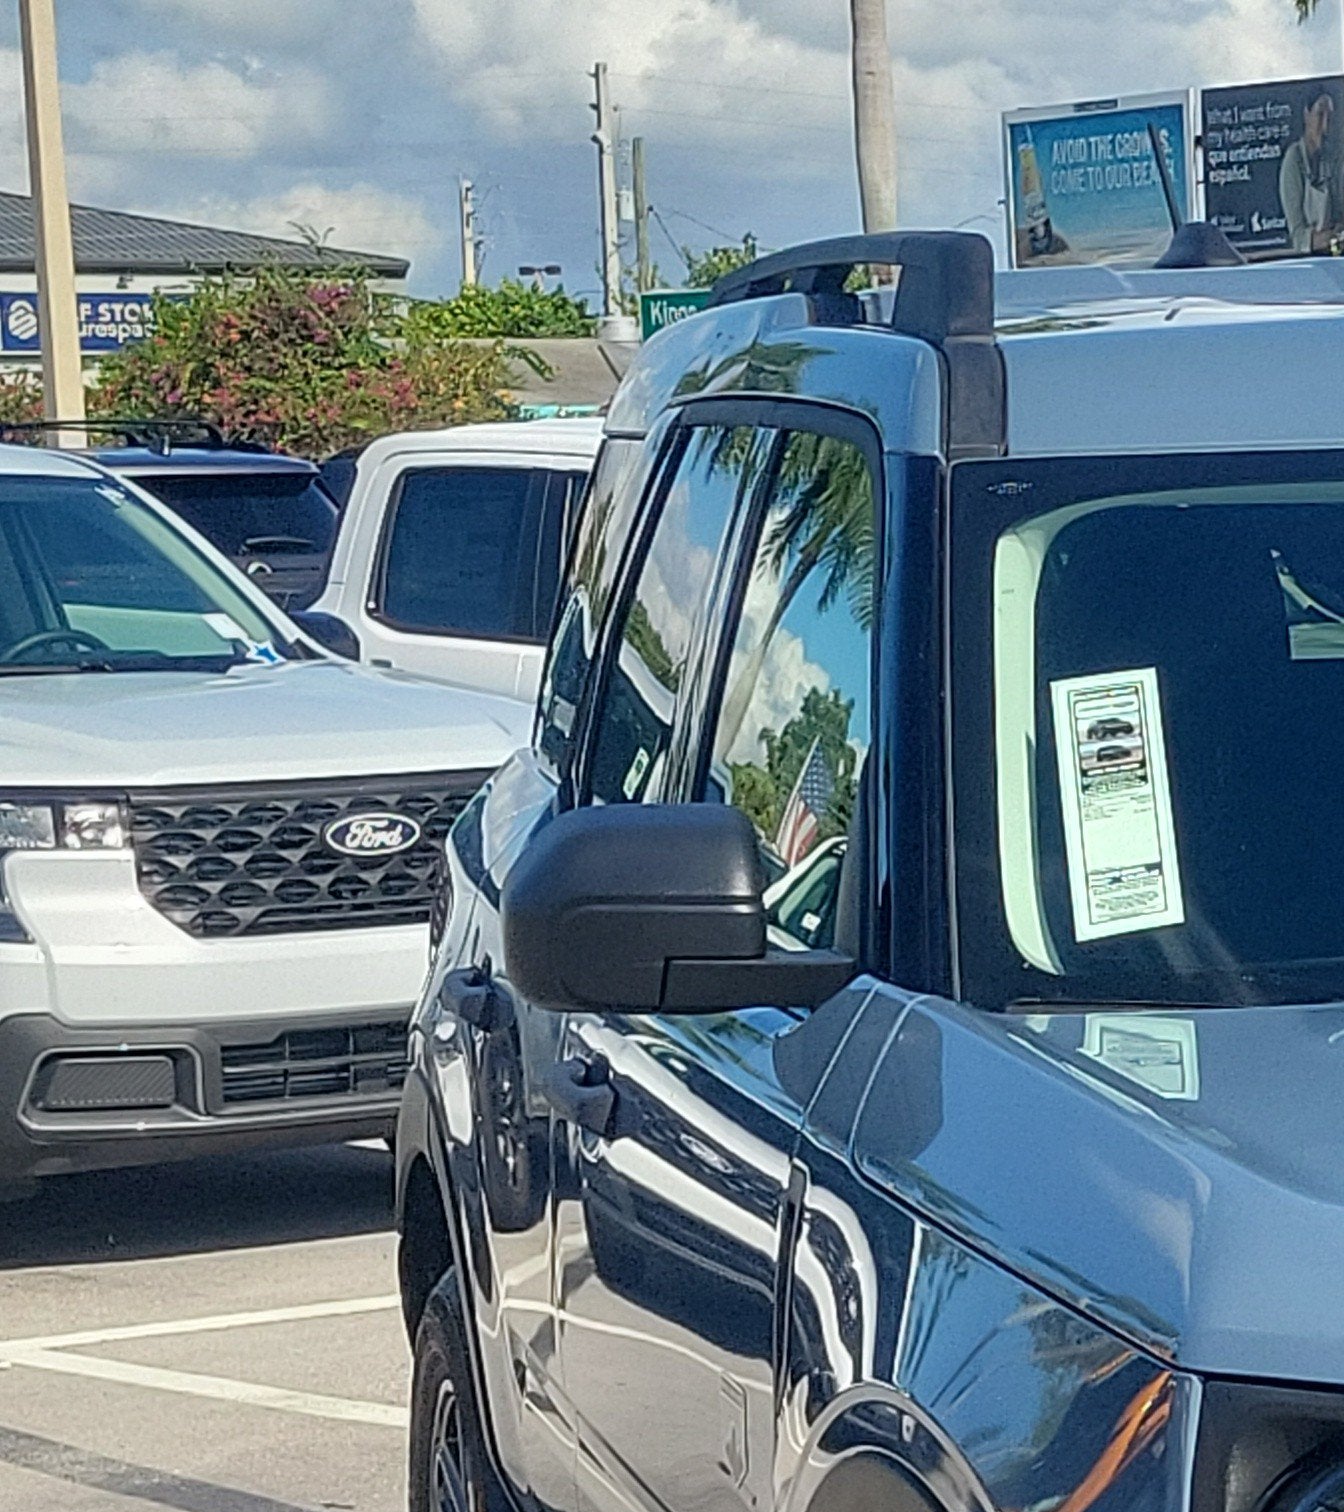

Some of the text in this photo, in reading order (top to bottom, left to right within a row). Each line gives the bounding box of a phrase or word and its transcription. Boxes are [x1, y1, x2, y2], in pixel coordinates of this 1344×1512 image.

[1052, 128, 1173, 165] AVOID THE CROWS.
[1051, 167, 1086, 194] COME
[1087, 166, 1104, 191] TO
[1105, 163, 1132, 190] OUR
[345, 820, 402, 848] Ford
